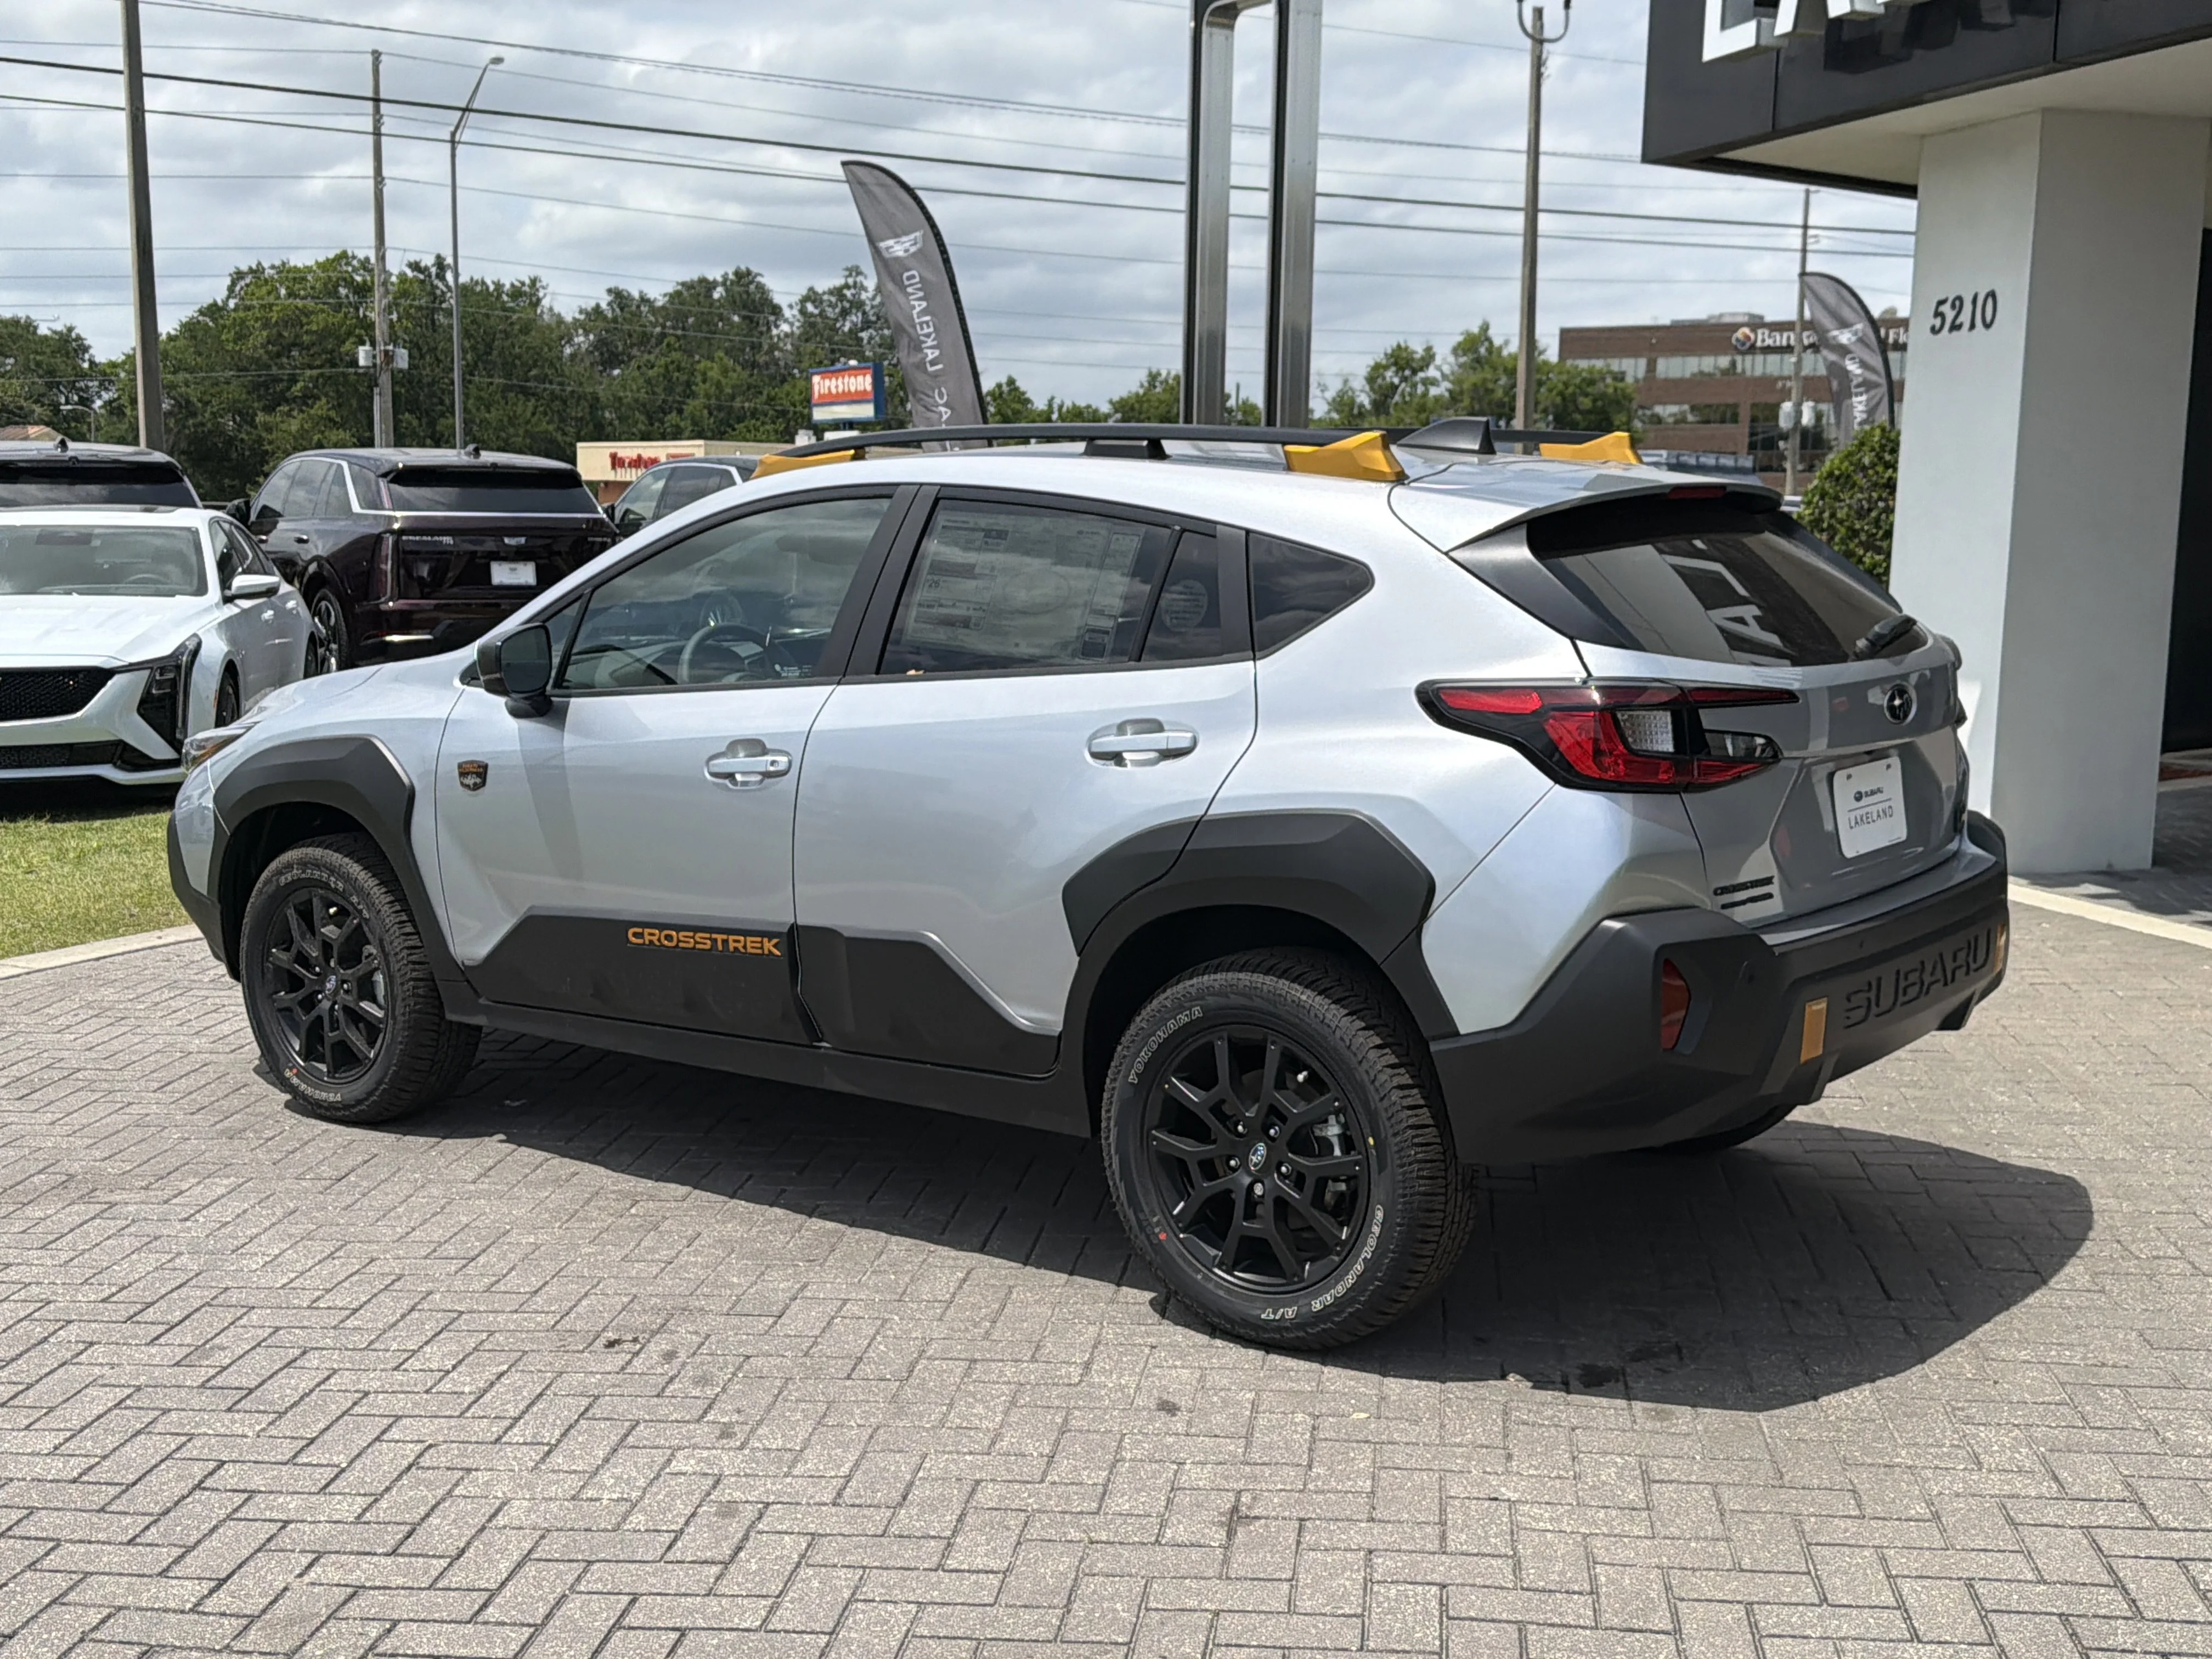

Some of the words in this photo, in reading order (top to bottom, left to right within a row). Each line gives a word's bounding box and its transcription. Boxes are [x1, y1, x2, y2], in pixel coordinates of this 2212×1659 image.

[1929, 289, 1997, 336] 5210
[1756, 328, 1803, 347] Ban
[812, 373, 873, 399] Firestone
[1848, 805, 1894, 830] LAKELAND
[627, 927, 782, 956] CROSSTREK
[1843, 927, 1991, 1030] SUBARU
[1127, 1006, 1203, 1084] YOKOHAMA
[1311, 1204, 1384, 1312] GEOLANDAR
[1261, 1306, 1297, 1320] A/T
